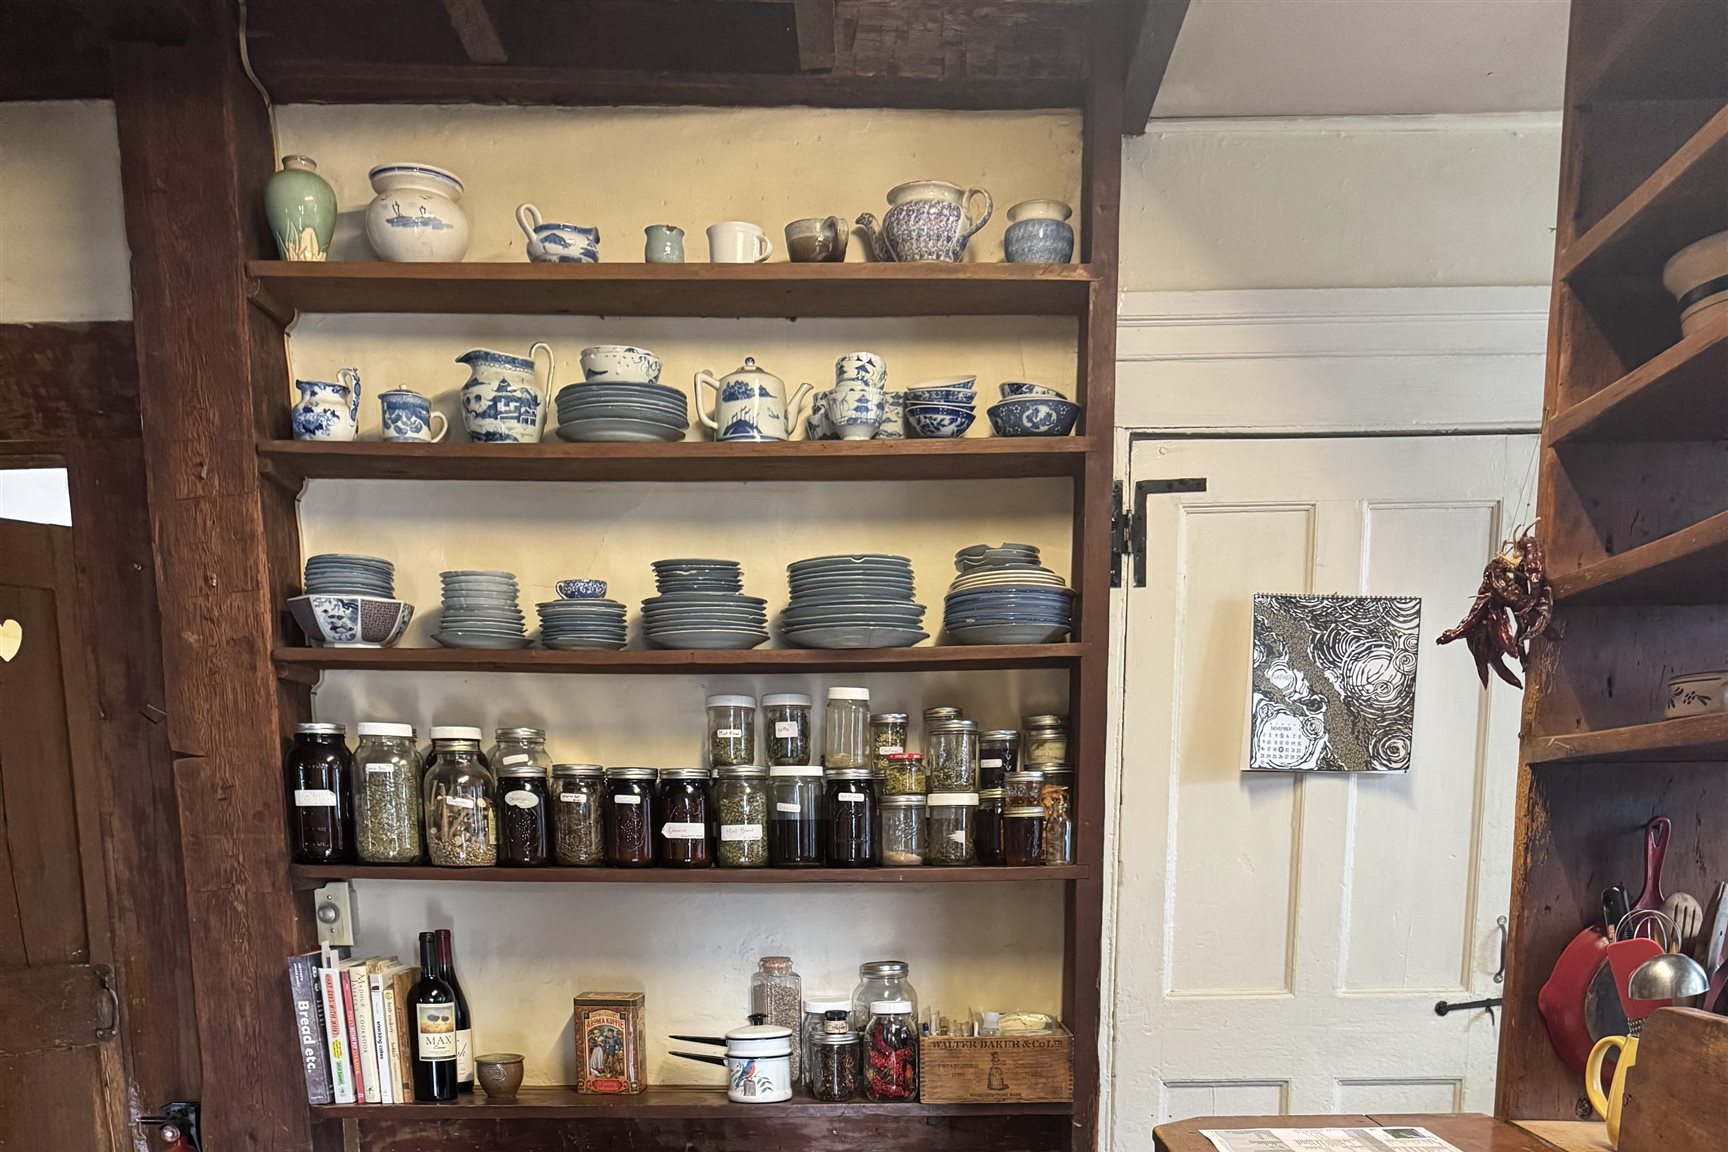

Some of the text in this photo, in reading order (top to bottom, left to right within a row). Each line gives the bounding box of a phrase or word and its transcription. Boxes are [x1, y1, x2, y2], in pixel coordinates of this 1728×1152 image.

[298, 1001, 316, 1073] Bread etc.
[426, 1036, 452, 1046] MAX
[933, 1040, 978, 1049] WALTER
[979, 1040, 1020, 1049] BAKER
